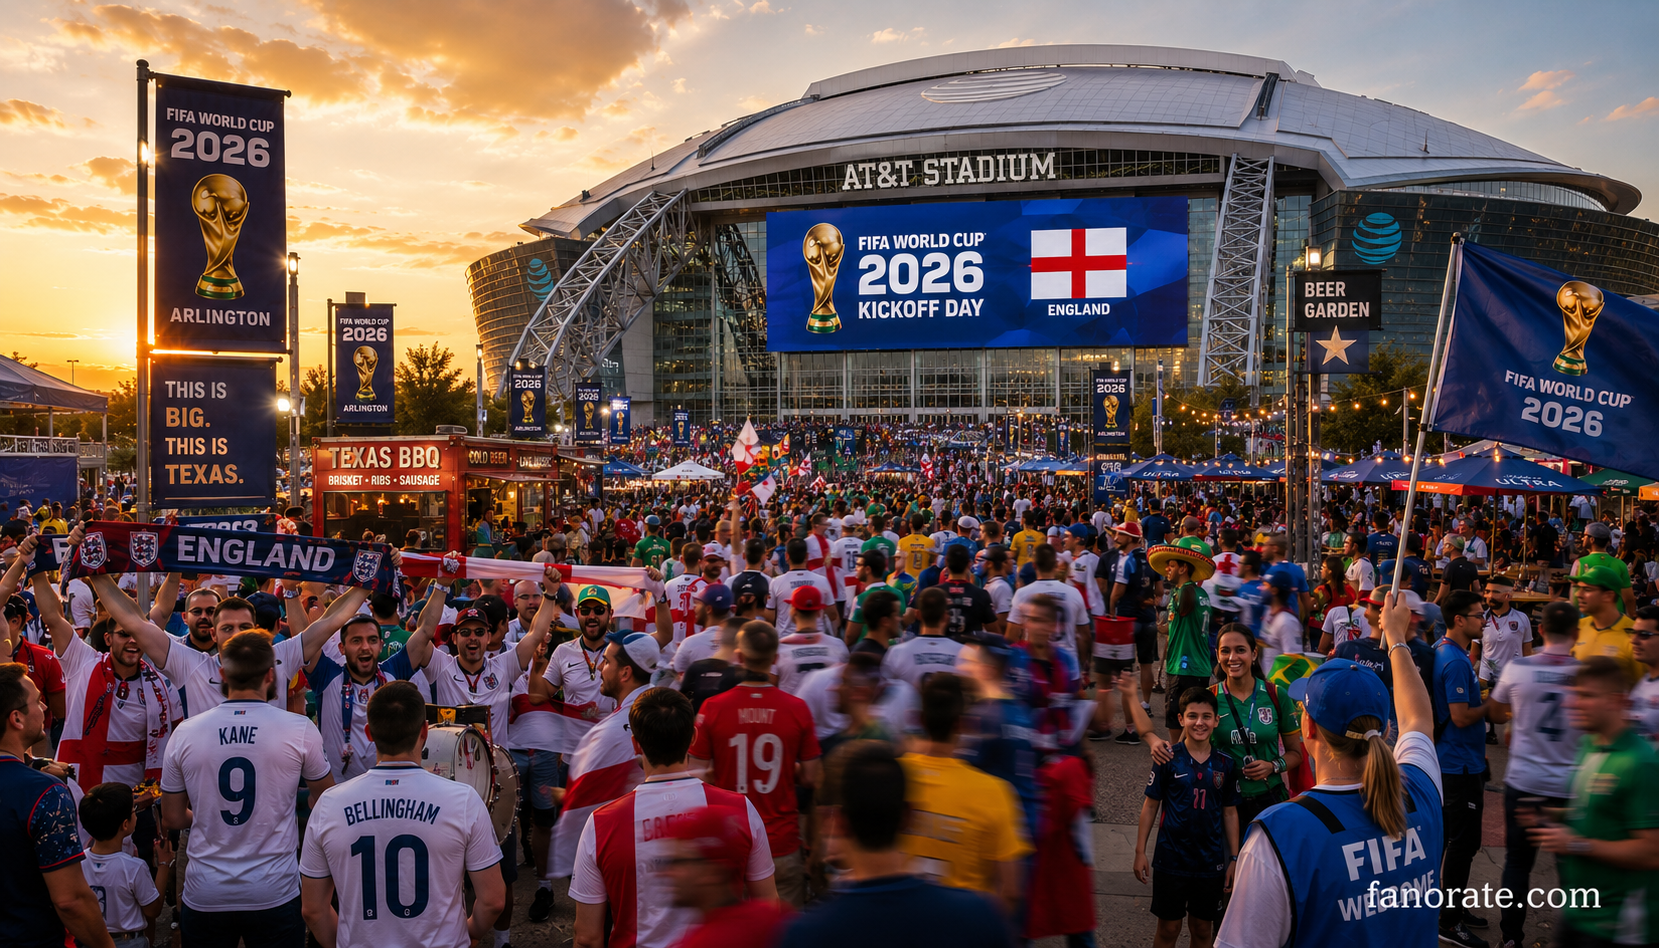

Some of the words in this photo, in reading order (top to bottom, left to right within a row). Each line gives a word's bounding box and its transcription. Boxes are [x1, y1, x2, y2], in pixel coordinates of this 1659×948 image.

[166, 107, 196, 124] FIFA
[198, 111, 247, 130] WORLD
[249, 118, 275, 133] CUP
[170, 128, 271, 168] 2026
[842, 159, 914, 191] AT&T
[923, 152, 1057, 185] STADIUM
[858, 235, 890, 251] FIFA
[892, 233, 950, 250] WORLD
[953, 232, 985, 248] CUP
[858, 250, 984, 296] 2026
[1304, 281, 1346, 298] BEER
[170, 307, 271, 326] ARLINGTON
[858, 299, 940, 320] KICKOFF
[945, 298, 984, 318] DAY
[1048, 303, 1111, 317] ENGLAND
[1304, 301, 1370, 318] GARDEN
[342, 327, 388, 342] 2026
[165, 381, 205, 399] THIS
[211, 382, 227, 399] IS
[514, 379, 542, 389] 2026
[1096, 384, 1126, 394] 2026
[1505, 369, 1536, 391] FIFA
[1539, 378, 1595, 403] WORLD
[1598, 390, 1632, 410] CUP
[165, 407, 211, 428] BIG.
[343, 404, 388, 413] ARLINGTON
[1521, 396, 1604, 438] 2026
[165, 437, 206, 455] THIS
[211, 437, 228, 455] IS
[328, 446, 392, 469] TEXAS
[398, 446, 441, 470] BBQ
[165, 464, 244, 485] TEXAS.
[328, 475, 363, 486] BRISKET
[371, 475, 391, 486] RIBS
[399, 474, 440, 486] SAUSAGE
[177, 534, 336, 573] ENGLAND
[737, 707, 777, 724] MOUNT
[218, 726, 258, 745] KANE
[728, 733, 784, 794] 19
[218, 756, 256, 827] 9
[343, 798, 441, 827] BELLINGHAM
[1341, 827, 1427, 882] FIFA
[350, 834, 429, 921] 10
